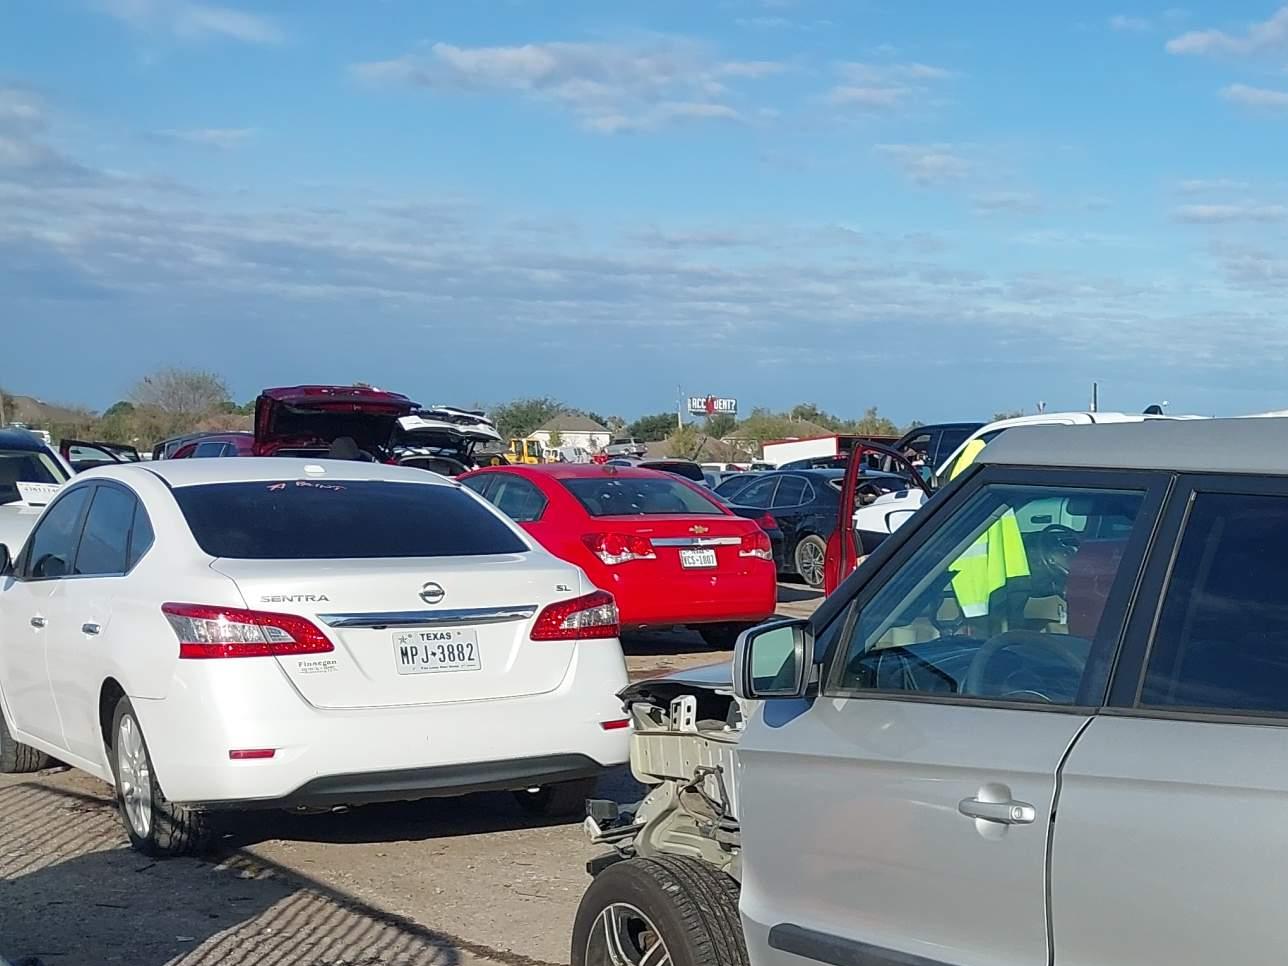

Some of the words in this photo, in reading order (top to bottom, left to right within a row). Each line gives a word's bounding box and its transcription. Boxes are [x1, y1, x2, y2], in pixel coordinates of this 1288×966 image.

[692, 397, 736, 410] ACCDENT?
[555, 584, 573, 592] SL
[260, 594, 330, 603] SENTRA
[419, 631, 452, 641] TEXAS
